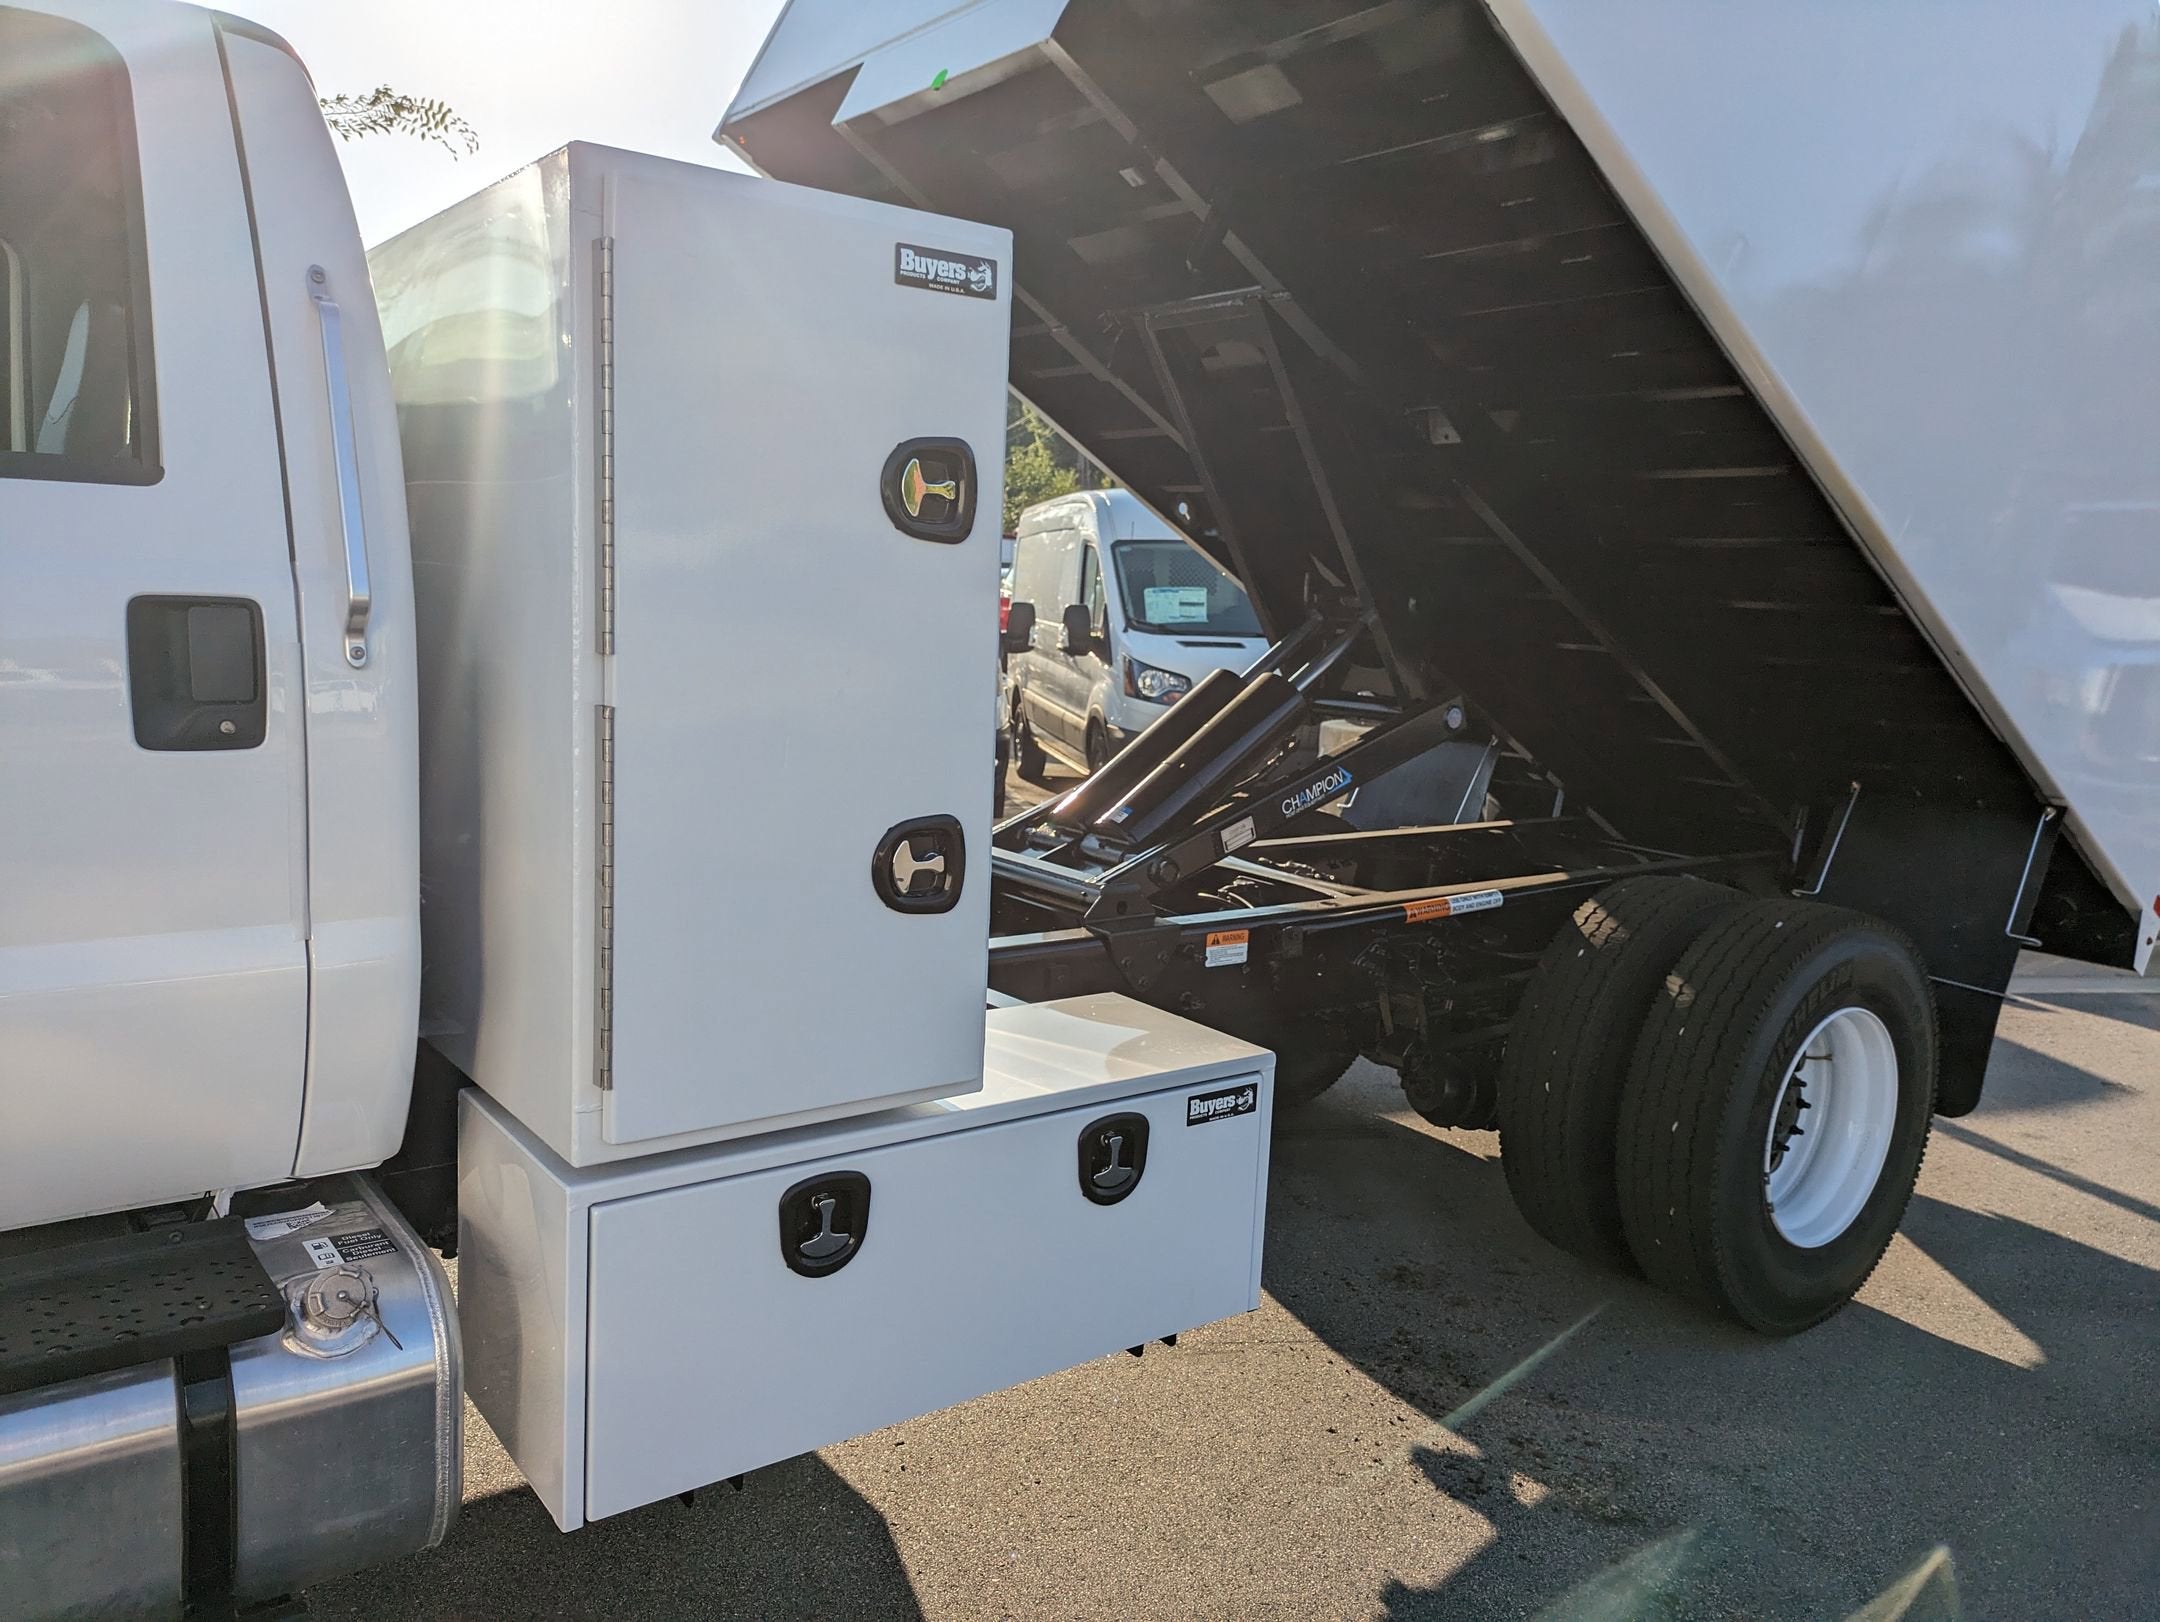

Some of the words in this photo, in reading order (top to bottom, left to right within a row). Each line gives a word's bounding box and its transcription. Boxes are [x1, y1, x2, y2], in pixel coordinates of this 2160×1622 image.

[900, 248, 966, 280] Buyers
[900, 270, 926, 279] PRODUCTS
[937, 276, 960, 285] COMPANY
[1281, 771, 1344, 814] CHAMPION
[1415, 903, 1449, 915] WARNING
[1222, 933, 1246, 942] WARNING
[1190, 1095, 1236, 1116] Buyers
[338, 1238, 359, 1246] Fuel
[341, 1232, 371, 1240] Diesel
[342, 1241, 389, 1253] Carburant
[352, 1246, 382, 1255] Diesel
[345, 1248, 396, 1261] Seulement
